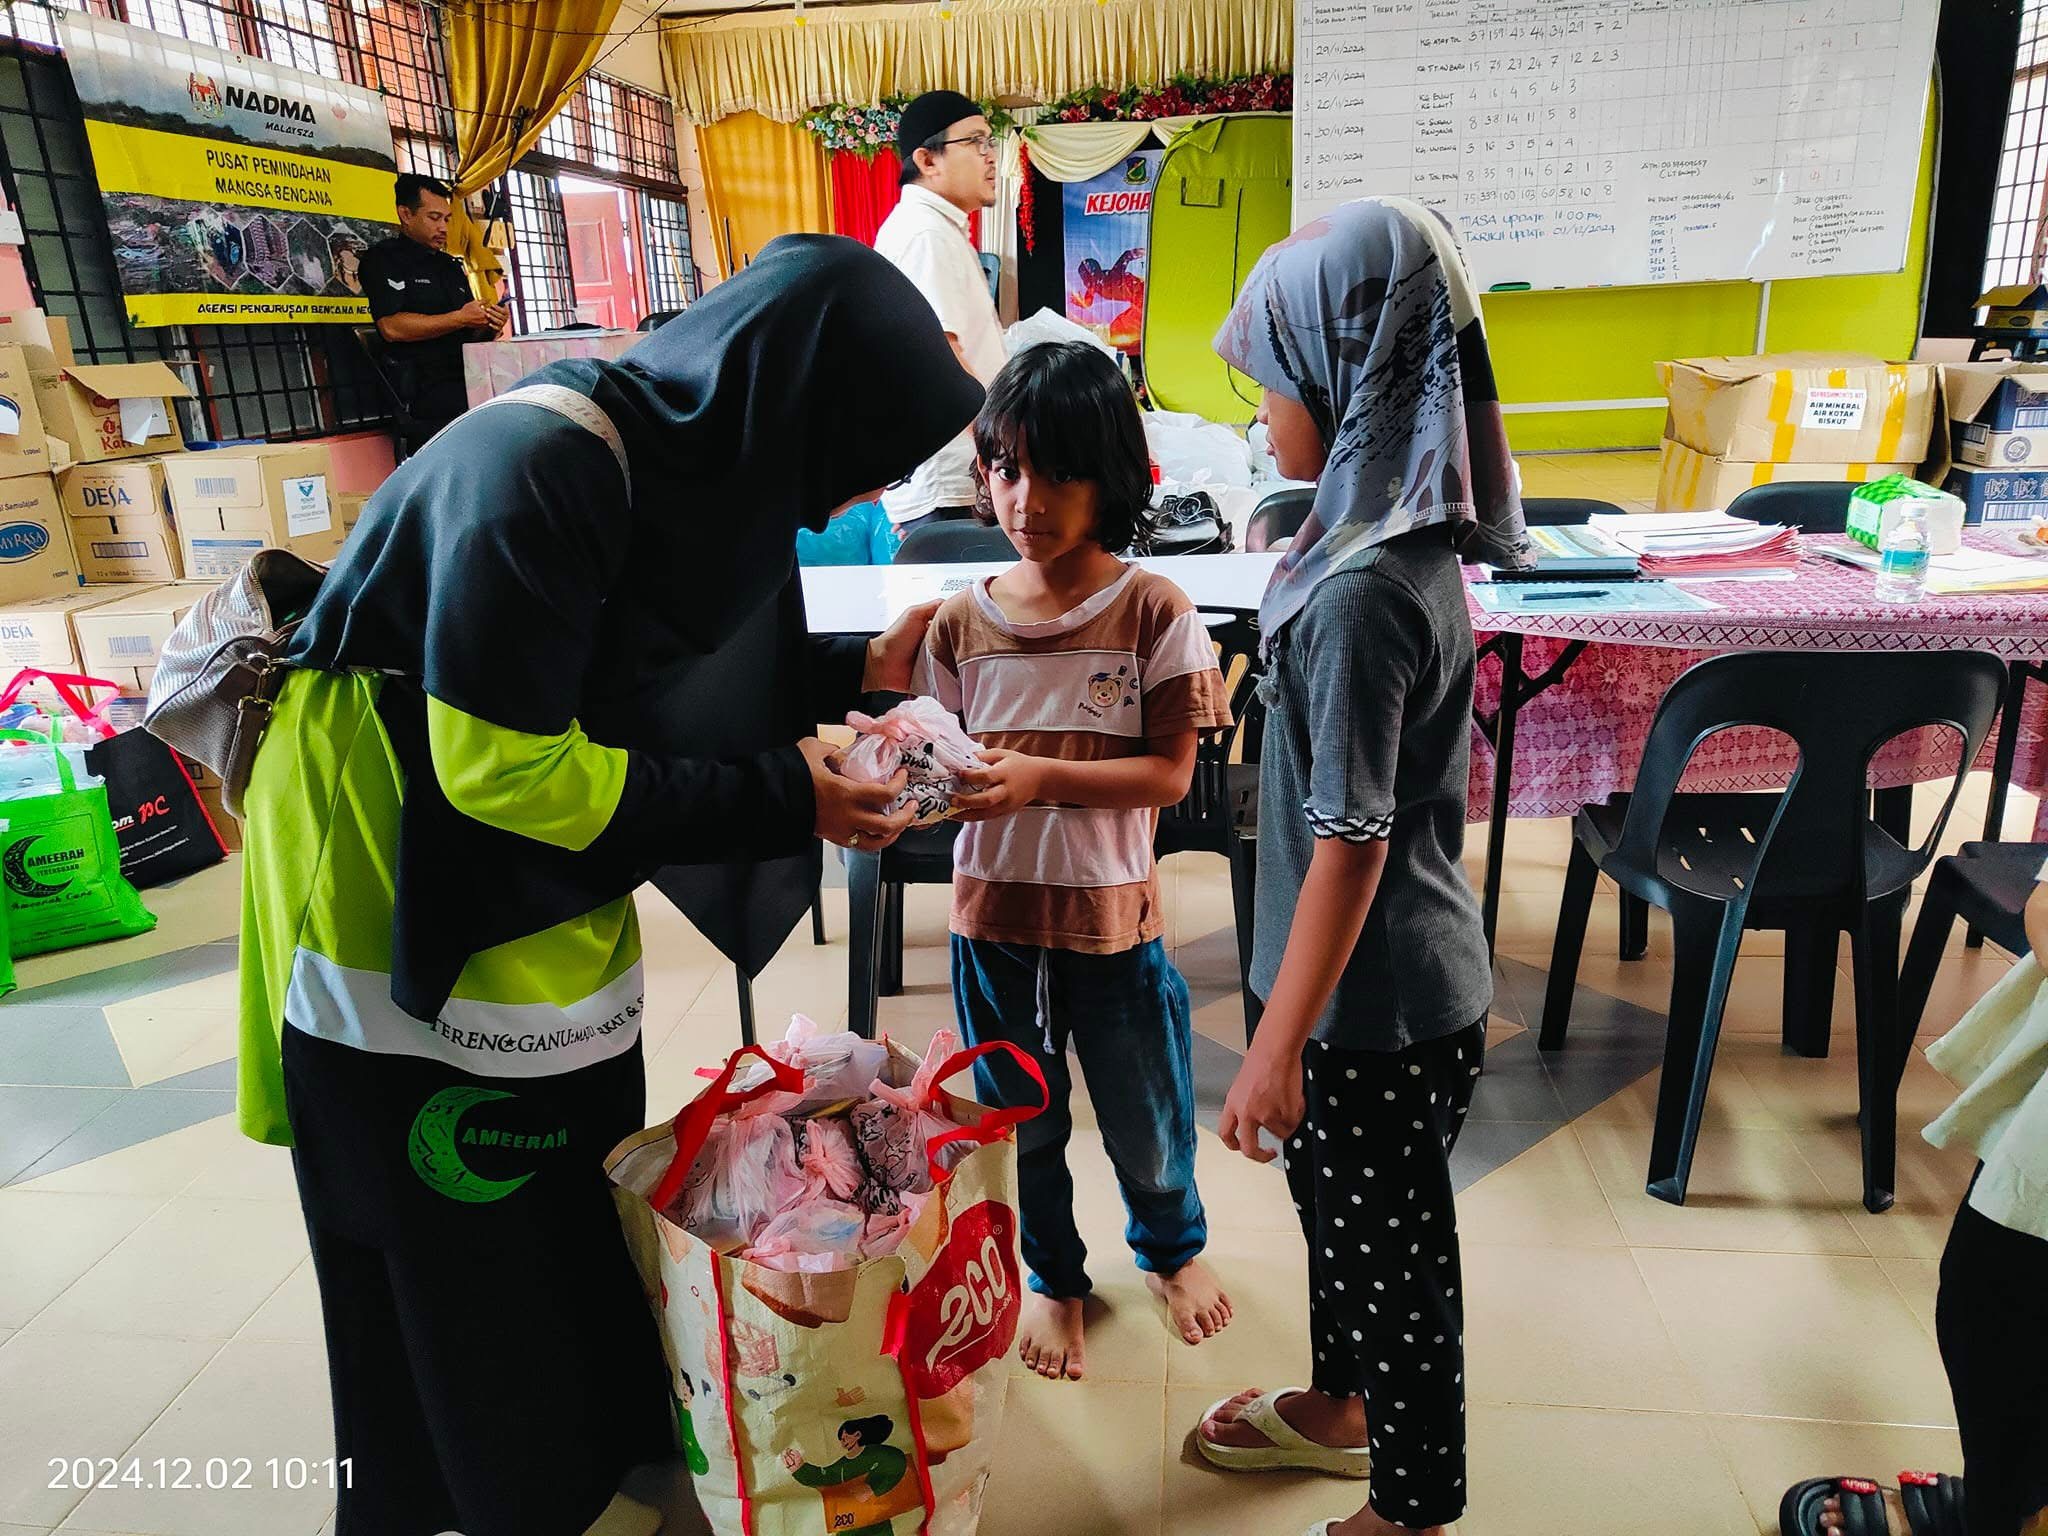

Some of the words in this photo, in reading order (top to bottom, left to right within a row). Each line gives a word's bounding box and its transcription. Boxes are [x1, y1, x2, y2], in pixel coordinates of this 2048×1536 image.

[225, 86, 316, 124] NADMA
[206, 149, 249, 171] PUSAT
[253, 157, 331, 184] PEMINDAHAN
[215, 177, 274, 200] MANGSA
[274, 184, 333, 206] BENCANA
[197, 303, 238, 314] AGENSI
[240, 304, 309, 315] PENGURUSAN
[311, 305, 355, 315] BENCANA
[82, 485, 132, 508] DESA
[1, 624, 34, 640] DESA
[28, 848, 85, 867] AMEERAH
[462, 1127, 568, 1149] AMEERAH
